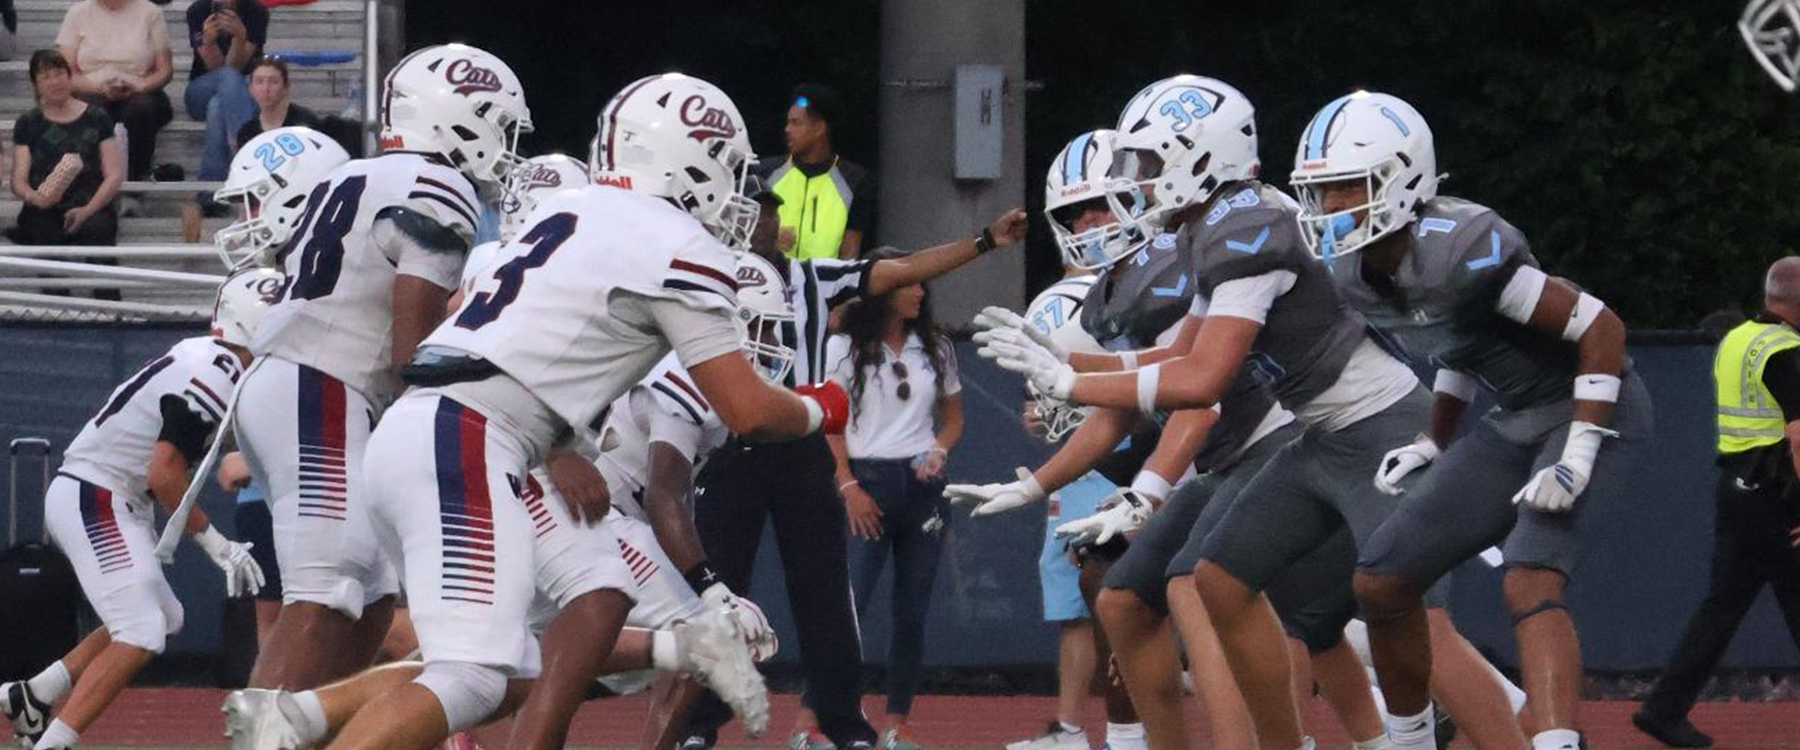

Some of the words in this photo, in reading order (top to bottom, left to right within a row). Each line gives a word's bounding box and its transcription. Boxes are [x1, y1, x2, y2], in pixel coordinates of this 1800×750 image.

[446, 58, 503, 97] Cats
[680, 94, 737, 143] Cats
[1160, 89, 1212, 133] 33
[253, 133, 306, 172] 28
[453, 211, 579, 332] 3
